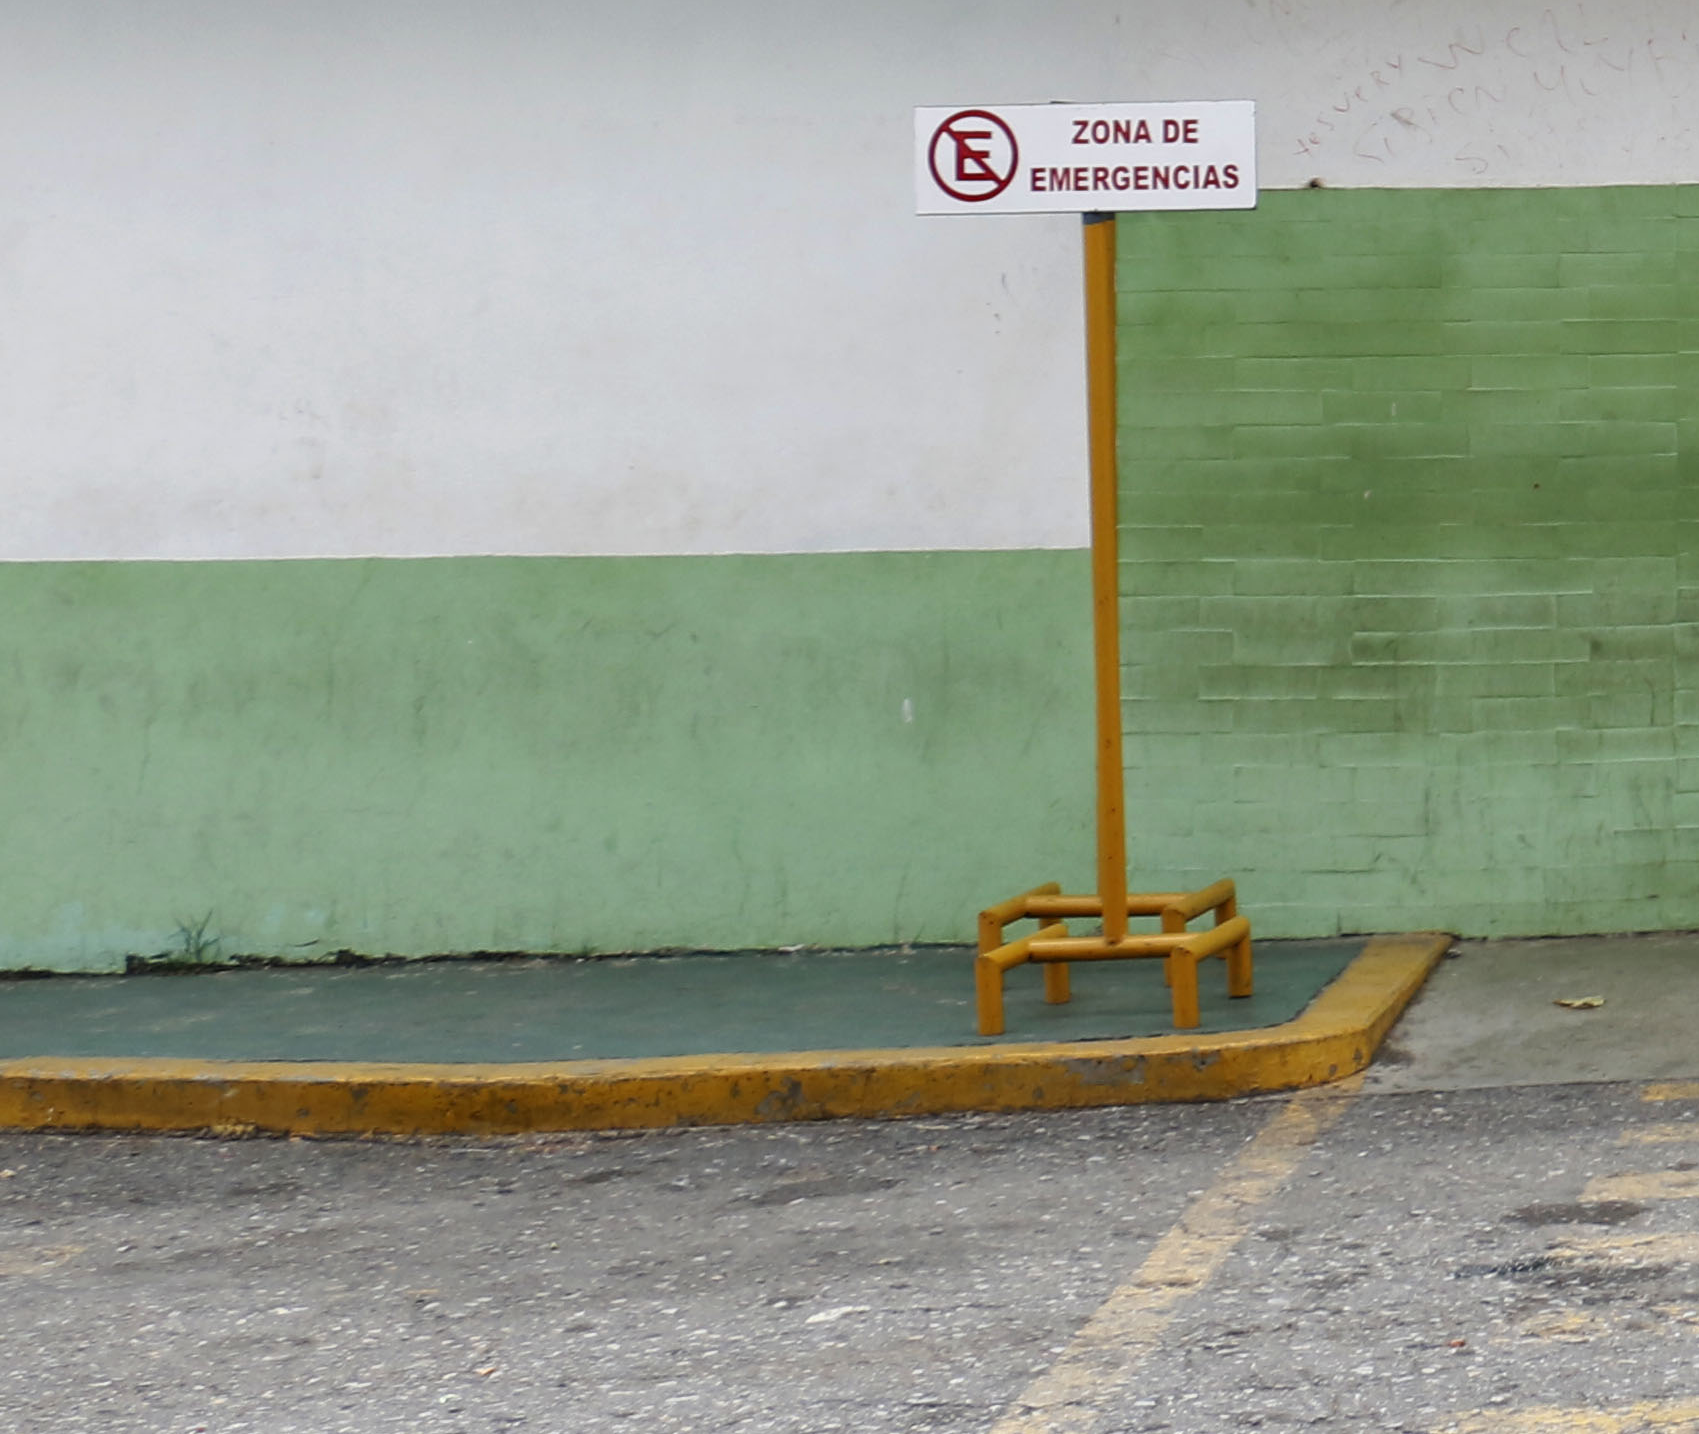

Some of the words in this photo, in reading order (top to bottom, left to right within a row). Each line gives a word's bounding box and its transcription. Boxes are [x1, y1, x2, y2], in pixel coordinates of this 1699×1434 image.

[1072, 120, 1150, 144] ZONA
[1163, 119, 1199, 143] DE
[1030, 165, 1239, 192] EMERGENCIAS
